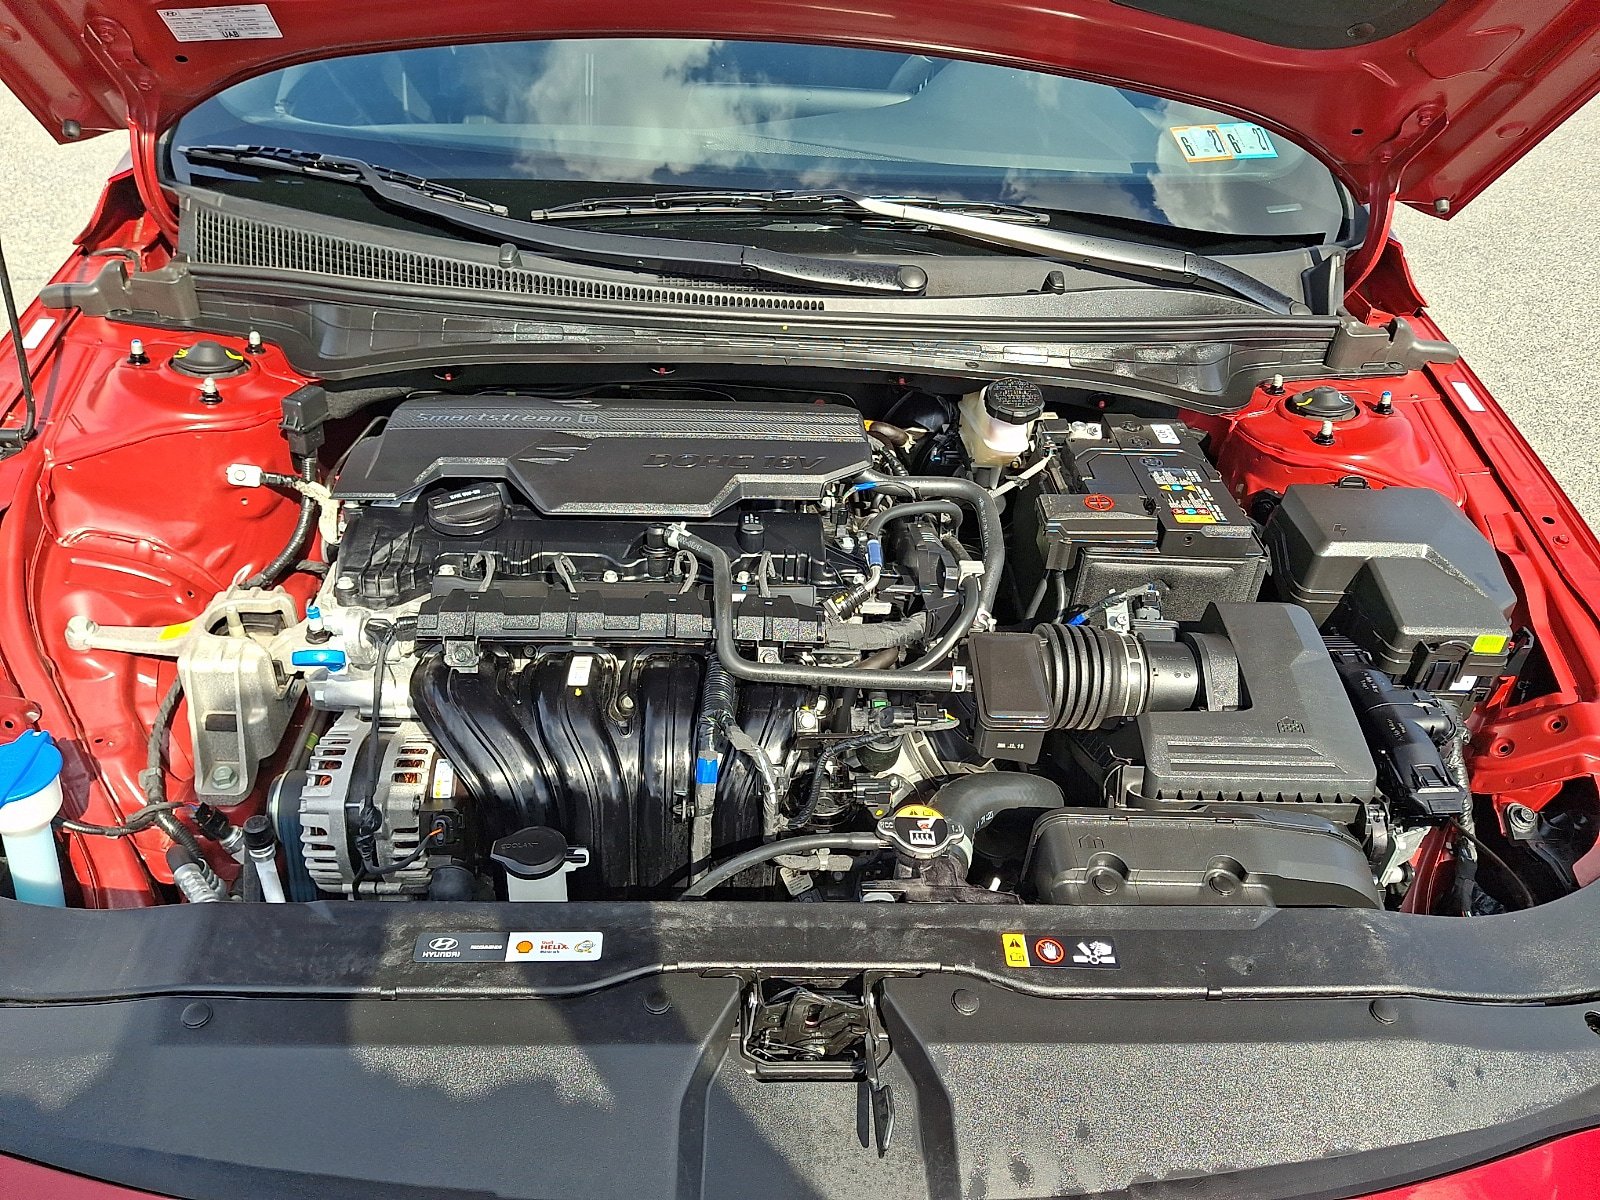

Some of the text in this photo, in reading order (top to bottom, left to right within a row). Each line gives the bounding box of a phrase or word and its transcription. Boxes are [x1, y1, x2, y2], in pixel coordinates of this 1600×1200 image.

[1181, 130, 1225, 156] 6 27
[1227, 128, 1270, 153] 6 27
[414, 413, 572, 422] Smartstream
[643, 454, 827, 470] DOHC 16V
